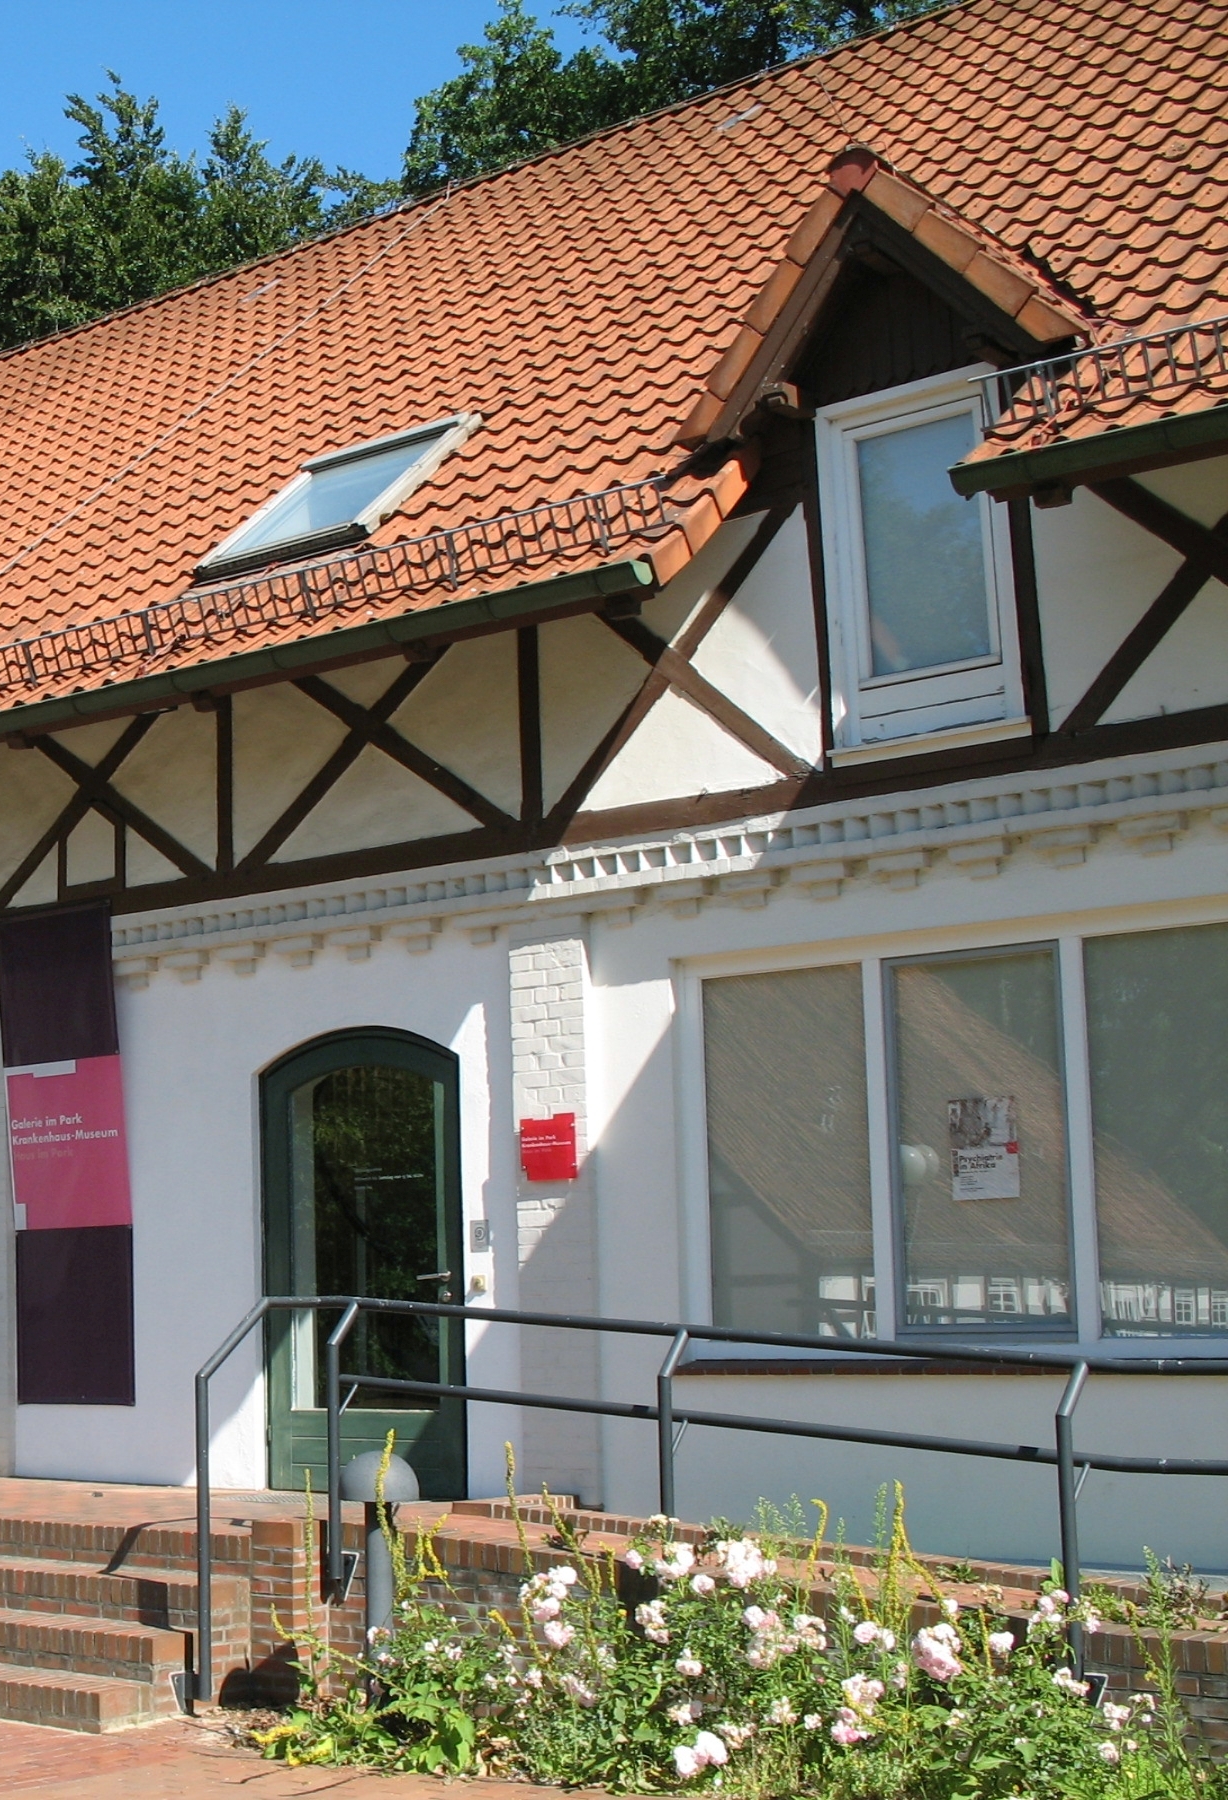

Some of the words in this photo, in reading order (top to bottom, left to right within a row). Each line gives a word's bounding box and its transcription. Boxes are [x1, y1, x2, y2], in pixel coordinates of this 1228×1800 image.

[11, 1117, 43, 1130] Galerie
[45, 1116, 57, 1127] im
[59, 1113, 83, 1125] Park
[12, 1128, 119, 1146] Krankenhaus-Museum
[14, 1150, 35, 1161] Haus
[37, 1149, 49, 1159] im
[50, 1146, 74, 1158] Park
[959, 1153, 1003, 1162] Psychiatrie
